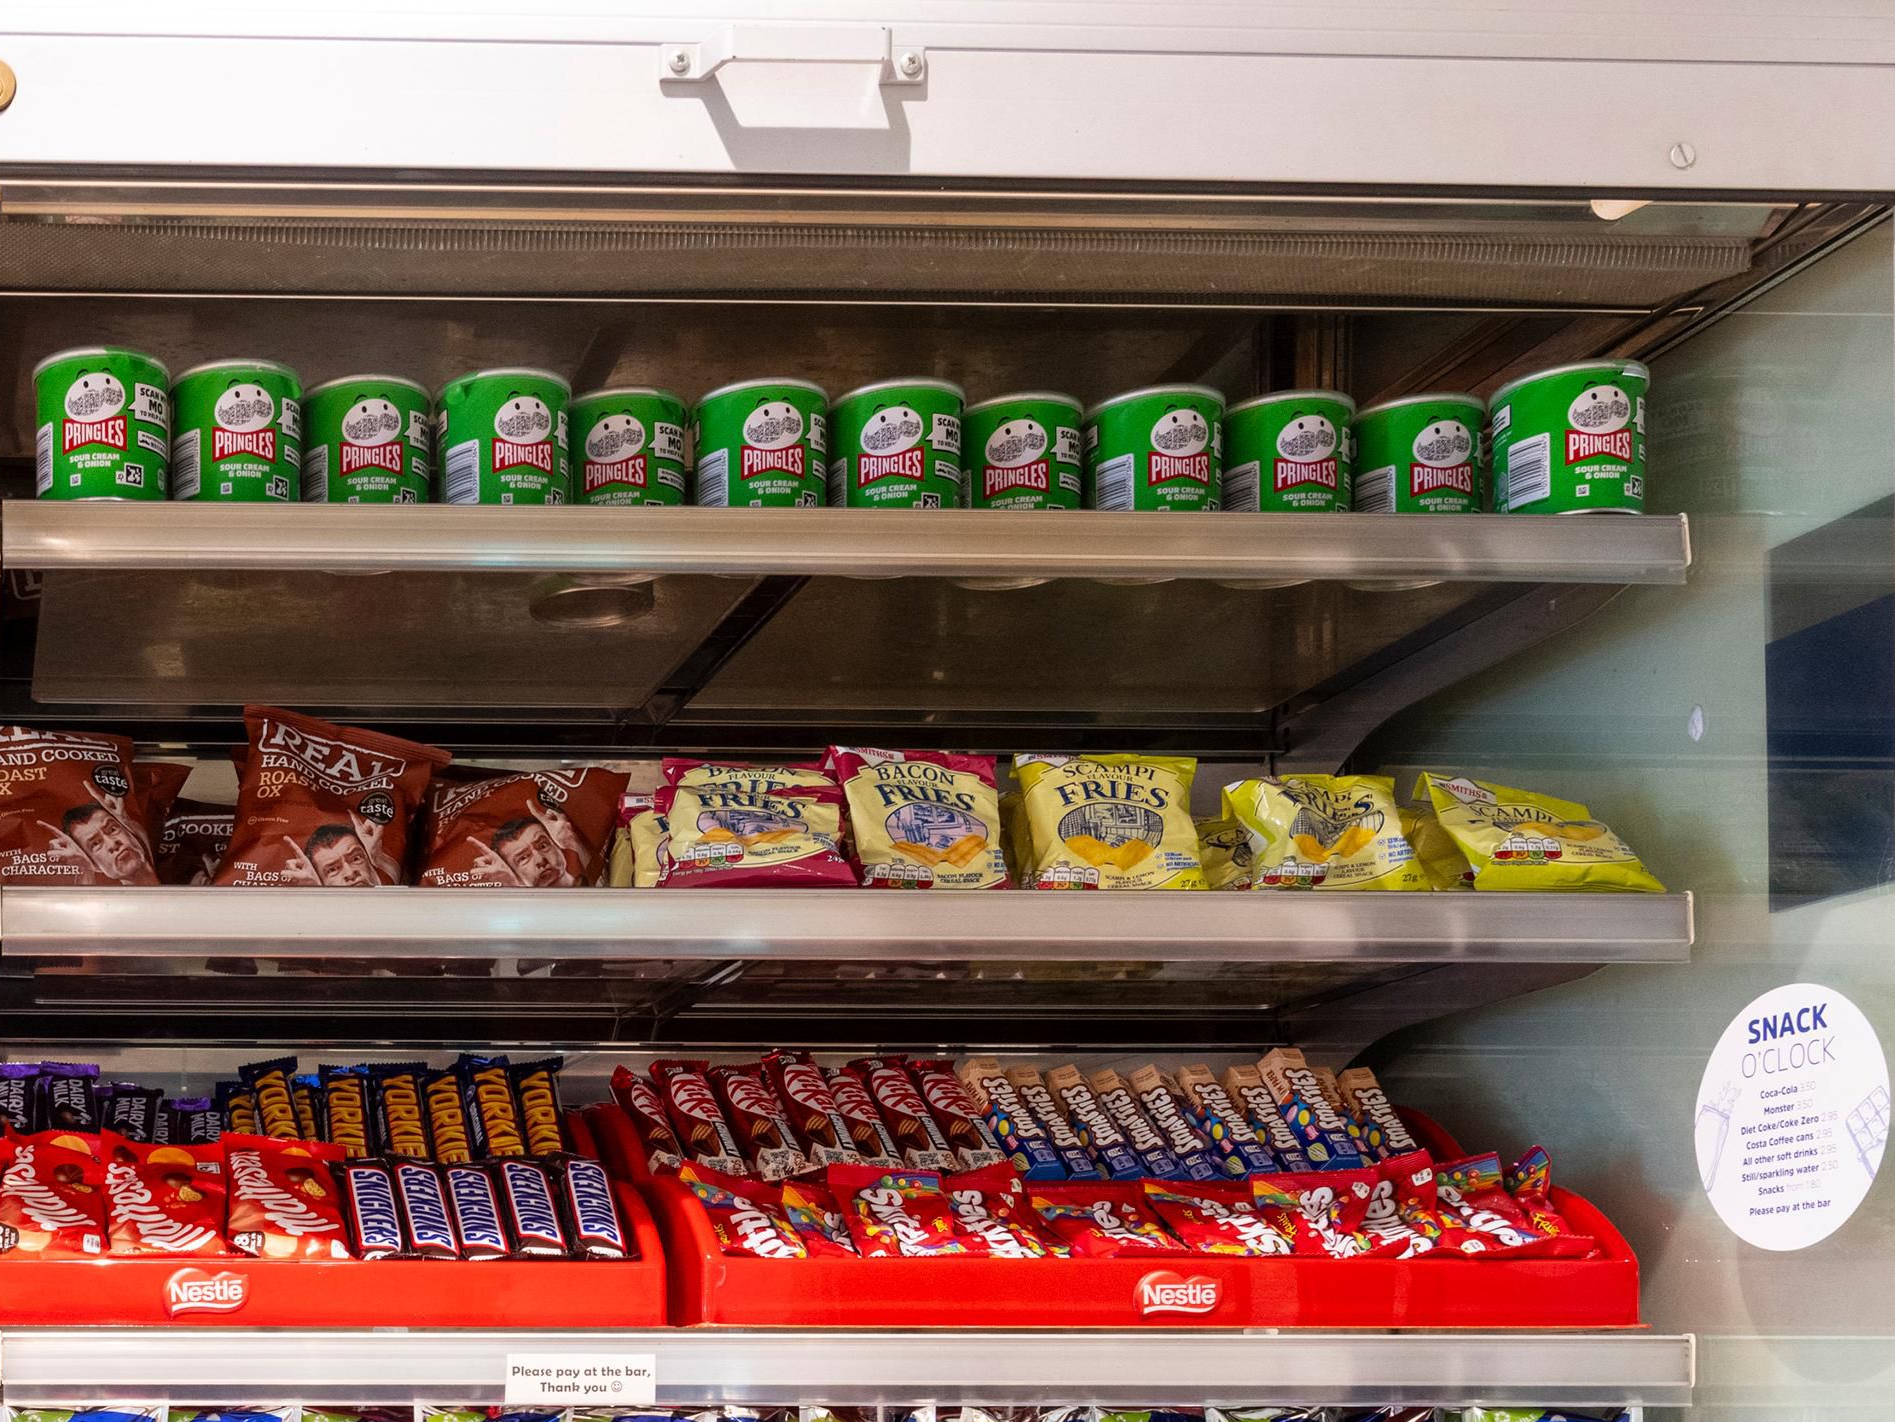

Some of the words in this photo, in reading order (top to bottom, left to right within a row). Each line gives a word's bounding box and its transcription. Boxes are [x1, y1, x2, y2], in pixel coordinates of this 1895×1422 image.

[64, 420, 124, 449] PRINGLES
[1568, 434, 1631, 462] PRINGLES
[69, 454, 89, 464] SOUR
[92, 453, 120, 462] CREAM
[86, 459, 111, 468] ONION
[1575, 466, 1598, 474] SOUR
[1601, 465, 1627, 473] CREAM
[1594, 471, 1620, 479] ONION
[41, 750, 120, 763] COOKED
[876, 765, 955, 786] BACON
[1062, 763, 1155, 781] SCAMPI
[897, 779, 938, 788] FLAVOUR
[1445, 781, 1483, 799] SMITHS
[874, 784, 976, 812] FRIES
[1054, 780, 1170, 810] FRIES
[1748, 1004, 1827, 1044] SNACK
[1742, 1036, 1836, 1078] O'CLOCK
[1760, 1086, 1798, 1099] Coca-Cola
[1764, 1104, 1794, 1115] Monster
[427, 1076, 470, 1164] YORKIE
[1741, 1127, 1756, 1135] Diet
[1758, 1121, 1799, 1132] Coke/Coke
[1801, 1116, 1819, 1125] Zero
[1746, 1141, 1767, 1150] Costa
[1769, 1136, 1793, 1146] Coffee
[1796, 1133, 1814, 1142] cans
[1743, 1158, 1752, 1166] All
[1755, 1156, 1774, 1164] other
[1777, 1152, 1792, 1161] soft
[1794, 1148, 1818, 1159] drinks
[1742, 1168, 1794, 1182] Still/sparkling
[1797, 1164, 1819, 1173] water
[1759, 1186, 1784, 1195] Snacks
[353, 1171, 399, 1247] SNICKERS
[1750, 1207, 1773, 1216] Please
[1776, 1205, 1790, 1213] pay
[1793, 1203, 1800, 1211] at
[1802, 1201, 1815, 1209] the
[1818, 1199, 1830, 1207] bar
[511, 1365, 553, 1377] Please
[556, 1368, 581, 1379] pay
[584, 1366, 598, 1377] at
[601, 1365, 622, 1377] the
[625, 1365, 651, 1378] bar,
[540, 1381, 581, 1393] Thank
[584, 1384, 607, 1394] you
